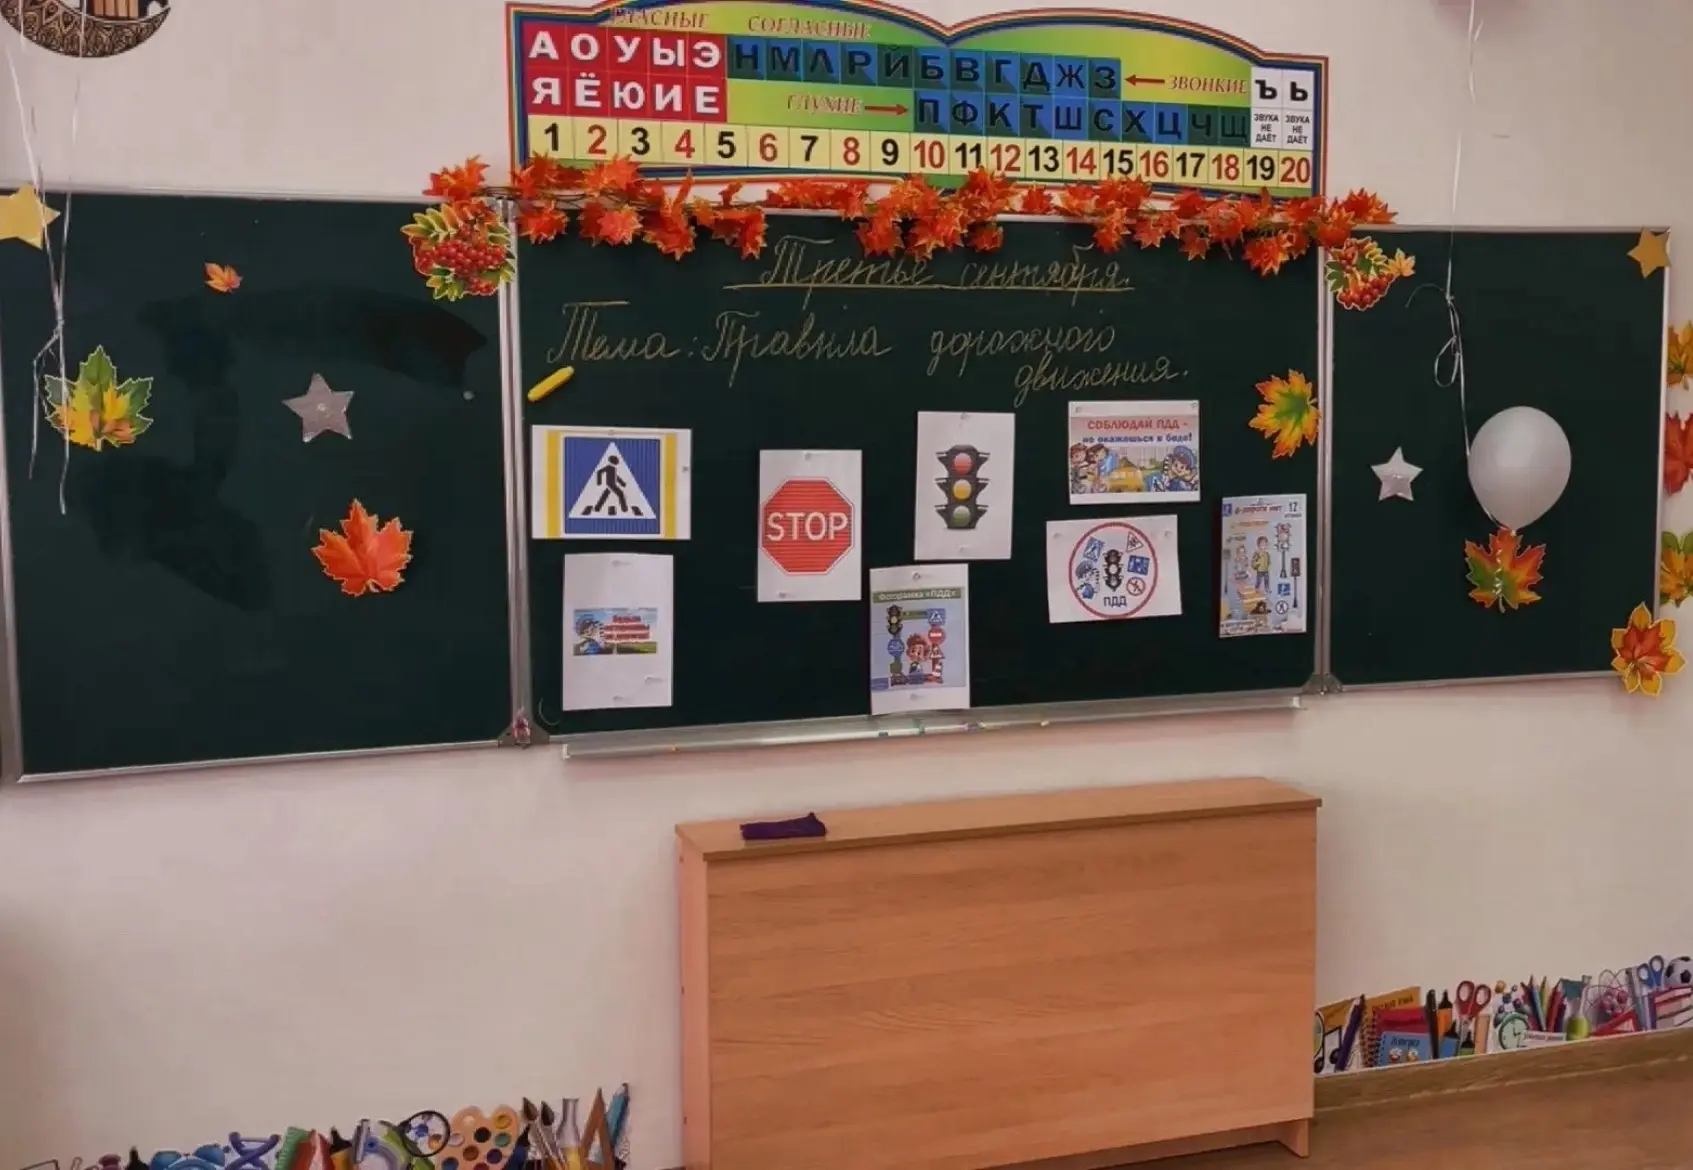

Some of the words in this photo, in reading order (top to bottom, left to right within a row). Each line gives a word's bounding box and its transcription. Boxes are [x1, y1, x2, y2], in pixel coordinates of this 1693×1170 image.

[748, 15, 872, 40] СОГЛАСНЫЕ
[528, 31, 559, 60] А
[570, 33, 600, 61] О
[613, 35, 641, 63] У
[652, 37, 685, 66] Ы
[692, 41, 721, 68] Э
[735, 44, 759, 71] Н
[771, 46, 800, 72] М
[810, 48, 834, 74] Л
[848, 50, 872, 76] Р
[921, 55, 944, 80] Б
[955, 57, 979, 82] В
[995, 59, 1012, 83] Г
[1023, 62, 1050, 92] Д
[1056, 64, 1085, 89] Ж
[1094, 66, 1116, 90] З
[532, 77, 561, 105] Я
[575, 72, 601, 108] Ё
[613, 81, 645, 110] Ю
[655, 83, 682, 112] И
[695, 86, 719, 114] Е
[1168, 75, 1248, 94] ЗВОНКИЕ
[787, 94, 863, 115] ГЛУХИЕ
[1254, 114, 1279, 122] ЗВУКА
[1285, 115, 1310, 124] ЗВУКА
[919, 99, 939, 124] П
[952, 100, 978, 126] Ф
[990, 102, 1012, 128] К
[1023, 104, 1044, 129] Т
[1055, 106, 1082, 130] Ш
[1094, 108, 1114, 131] С
[1124, 110, 1147, 134] Х
[1158, 111, 1182, 140] Ц
[1191, 113, 1211, 137] Ч
[1221, 115, 1248, 142] Щ
[1261, 124, 1272, 132] НЕ
[544, 122, 559, 152] 1
[587, 124, 607, 155] 2
[631, 127, 650, 156] 3
[674, 129, 695, 158] 4
[717, 131, 736, 159] 5
[759, 132, 778, 162] 6
[800, 135, 819, 162] 7
[843, 136, 861, 166] 8
[881, 138, 899, 166] 9
[913, 140, 945, 169] 10
[955, 142, 982, 169] 11
[990, 143, 1021, 172] 12
[1028, 145, 1059, 172] 13
[1066, 147, 1097, 175] 14
[1103, 148, 1134, 175] 15
[1140, 150, 1169, 178] 16
[1176, 152, 1206, 178] 17
[1212, 153, 1240, 181] 18
[1246, 154, 1275, 182] 19
[1280, 155, 1311, 183] 20
[760, 235, 934, 309] Третье
[702, 311, 893, 388] Правила
[926, 326, 1115, 377] дорожного
[1014, 352, 1188, 408] движения.
[1088, 417, 1152, 431] СОБЛЮДАЙ
[1157, 419, 1180, 430] ПДД
[767, 511, 848, 541] STOP
[1104, 596, 1127, 608] ПДД
